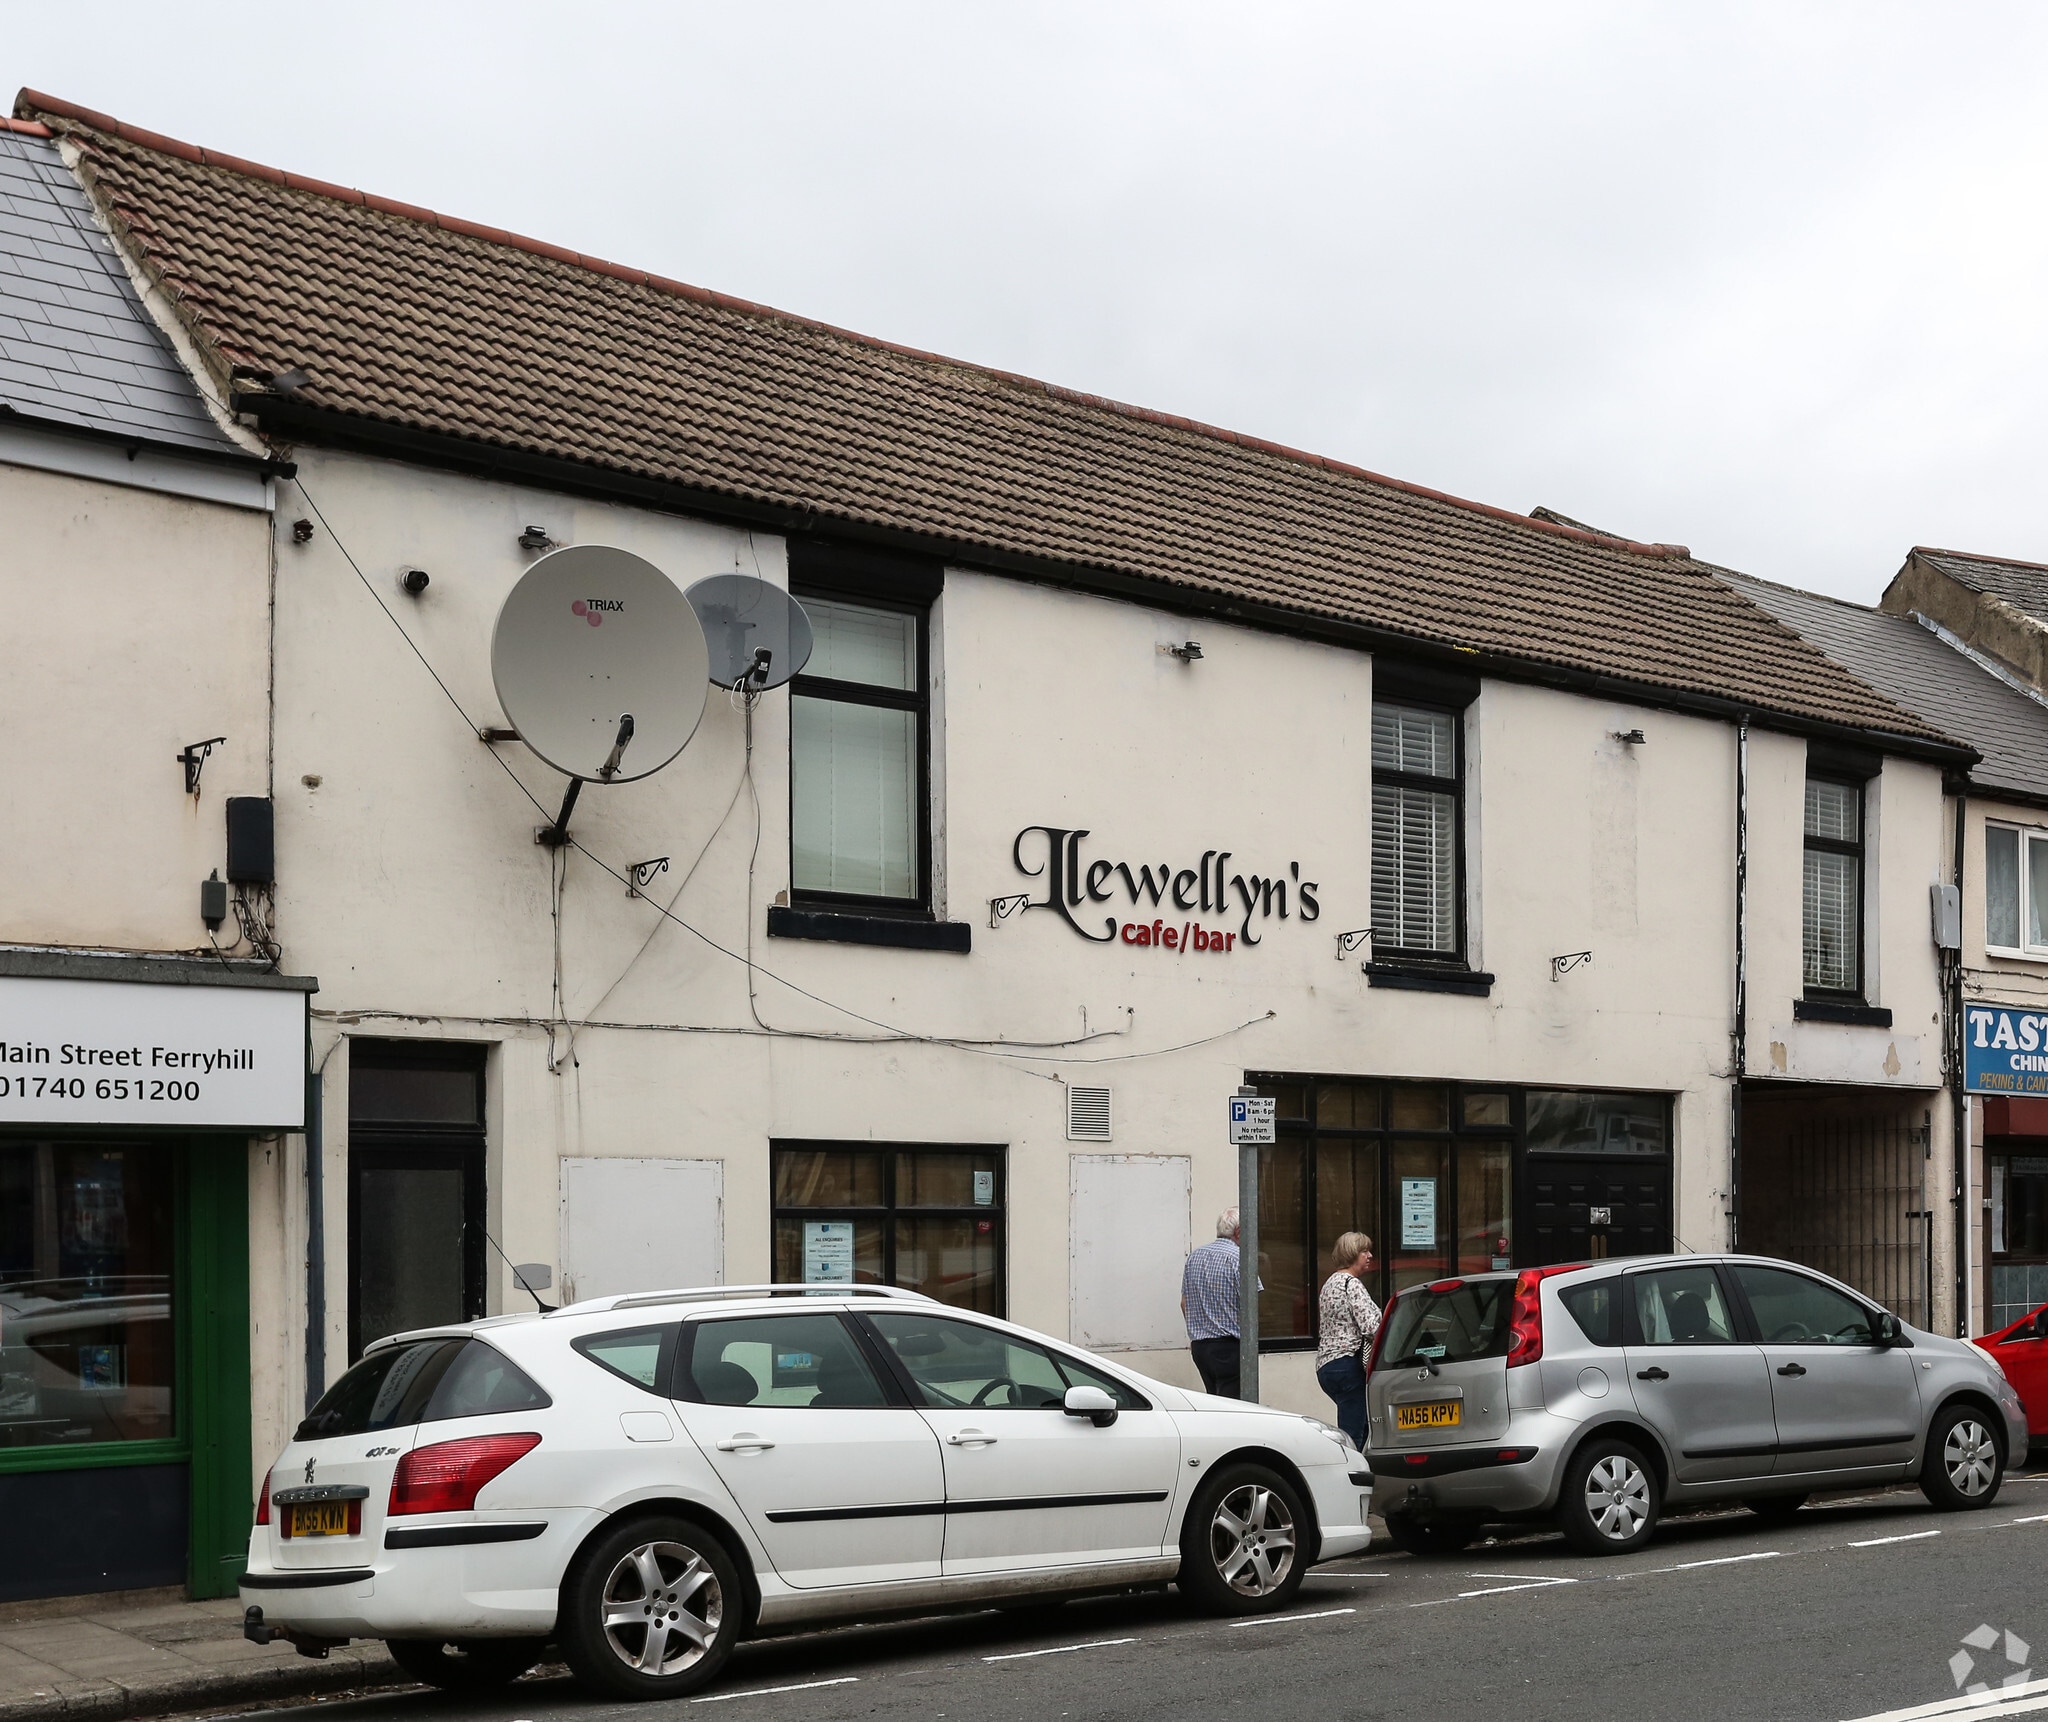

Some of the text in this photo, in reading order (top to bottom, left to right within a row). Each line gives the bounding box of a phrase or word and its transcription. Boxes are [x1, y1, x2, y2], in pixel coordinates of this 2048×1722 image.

[587, 599, 624, 612] TRIAX
[1012, 825, 1321, 945] Llewellyn's
[1121, 919, 1237, 953] cafe/bar
[60, 1044, 142, 1066] Street
[152, 1047, 254, 1074] Ferryhill
[0, 1077, 200, 1101] 01740 651200
[1979, 1073, 2015, 1090] PEKING
[2016, 1076, 2023, 1090] &
[1235, 1105, 1244, 1119] P
[1402, 1405, 1454, 1425] NA56 KPV
[295, 1504, 344, 1531] BK56 KWN
